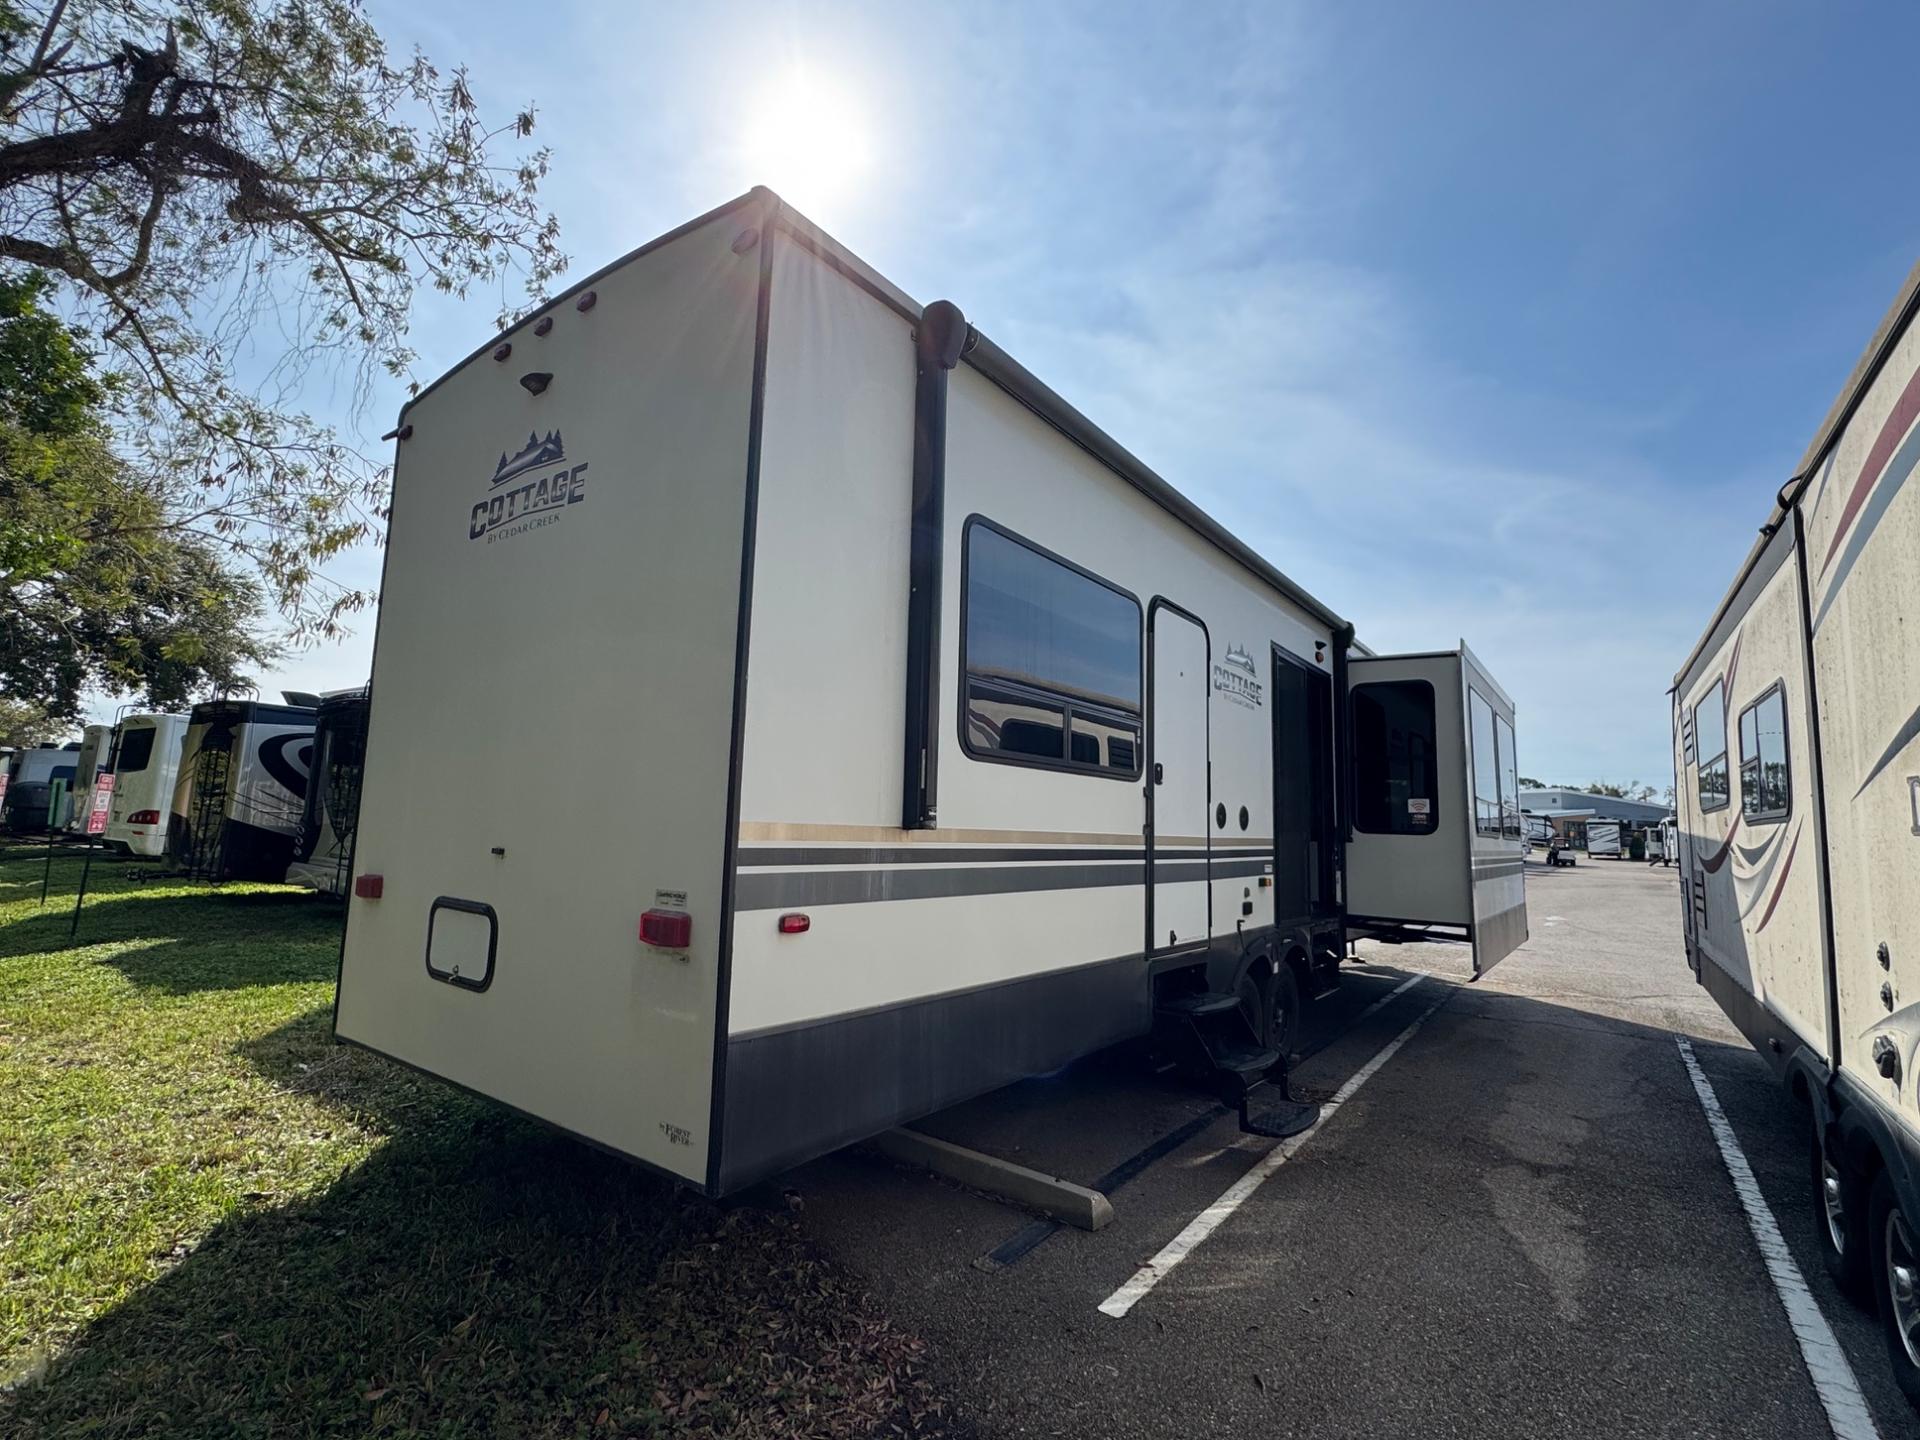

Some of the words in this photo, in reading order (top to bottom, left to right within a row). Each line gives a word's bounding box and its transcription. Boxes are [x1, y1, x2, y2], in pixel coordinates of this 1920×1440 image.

[469, 462, 588, 540] COTTAGE
[499, 523, 528, 540] CEDAR
[529, 512, 561, 530] CREEK
[1214, 665, 1262, 706] COTTAGE
